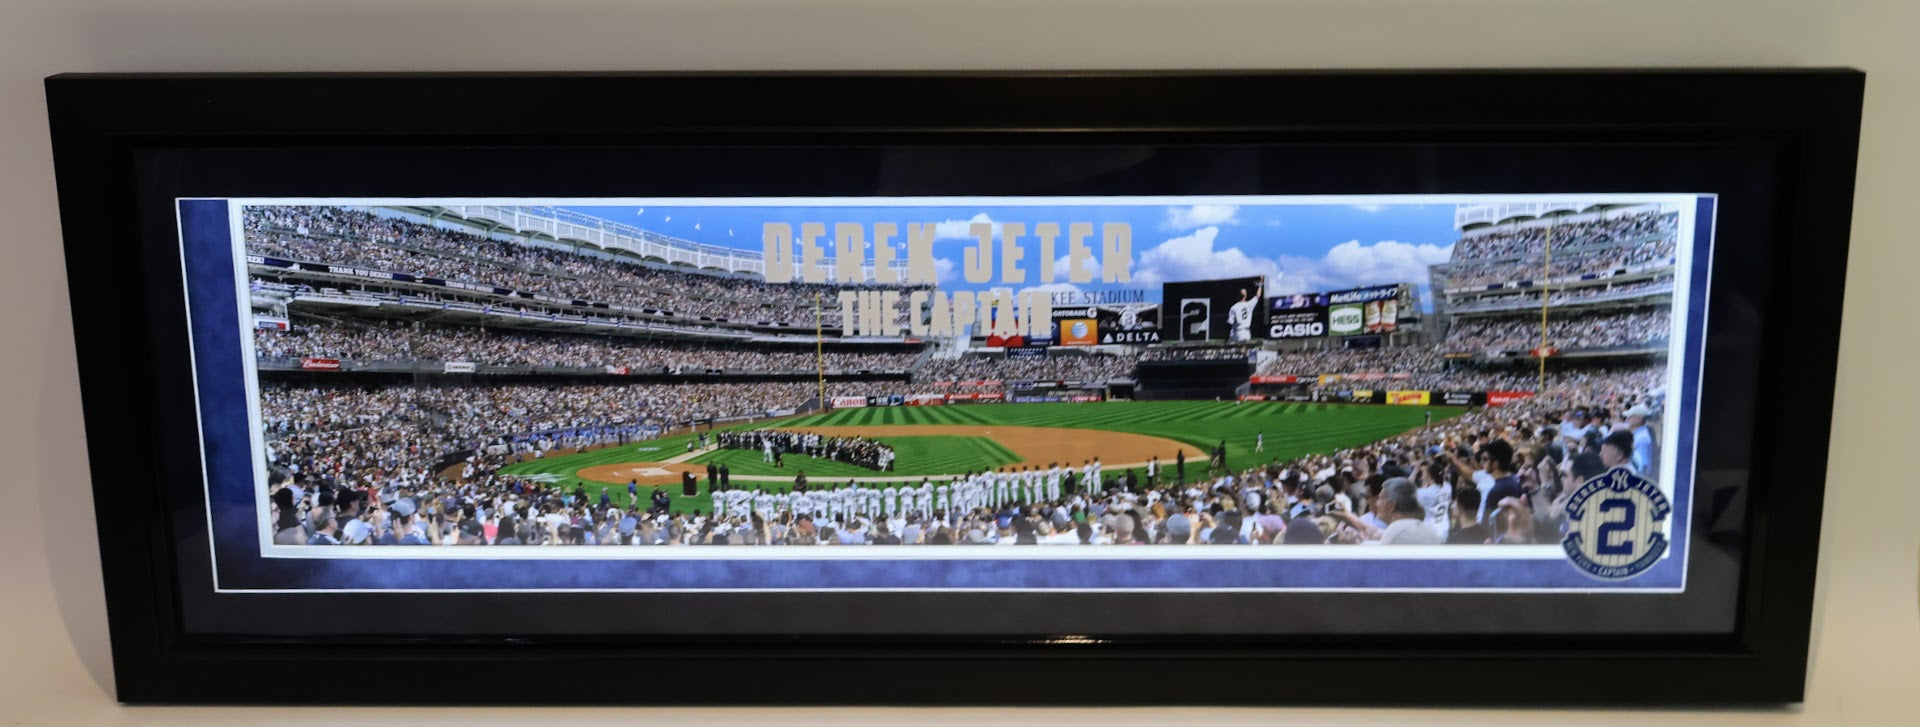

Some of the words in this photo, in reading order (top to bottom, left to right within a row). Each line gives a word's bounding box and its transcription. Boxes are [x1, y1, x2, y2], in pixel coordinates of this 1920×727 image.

[763, 222, 937, 283] DEREK
[964, 222, 1133, 283] JETER
[328, 265, 354, 274] THANK
[355, 268, 369, 277] YOU
[1084, 290, 1144, 305] STADIUM
[1330, 291, 1361, 303] MetLife
[838, 291, 901, 336] THE
[910, 291, 1052, 336] CAPTAIN
[1053, 309, 1087, 318] GATORADE
[1333, 314, 1360, 325] HESS
[1270, 322, 1324, 338] CASIO
[1117, 332, 1160, 342] DELTA
[1569, 478, 1606, 511] DEREK
[1637, 479, 1667, 511] JETER
[1597, 499, 1635, 555] 2
[1597, 566, 1629, 577] CAPTAIN
